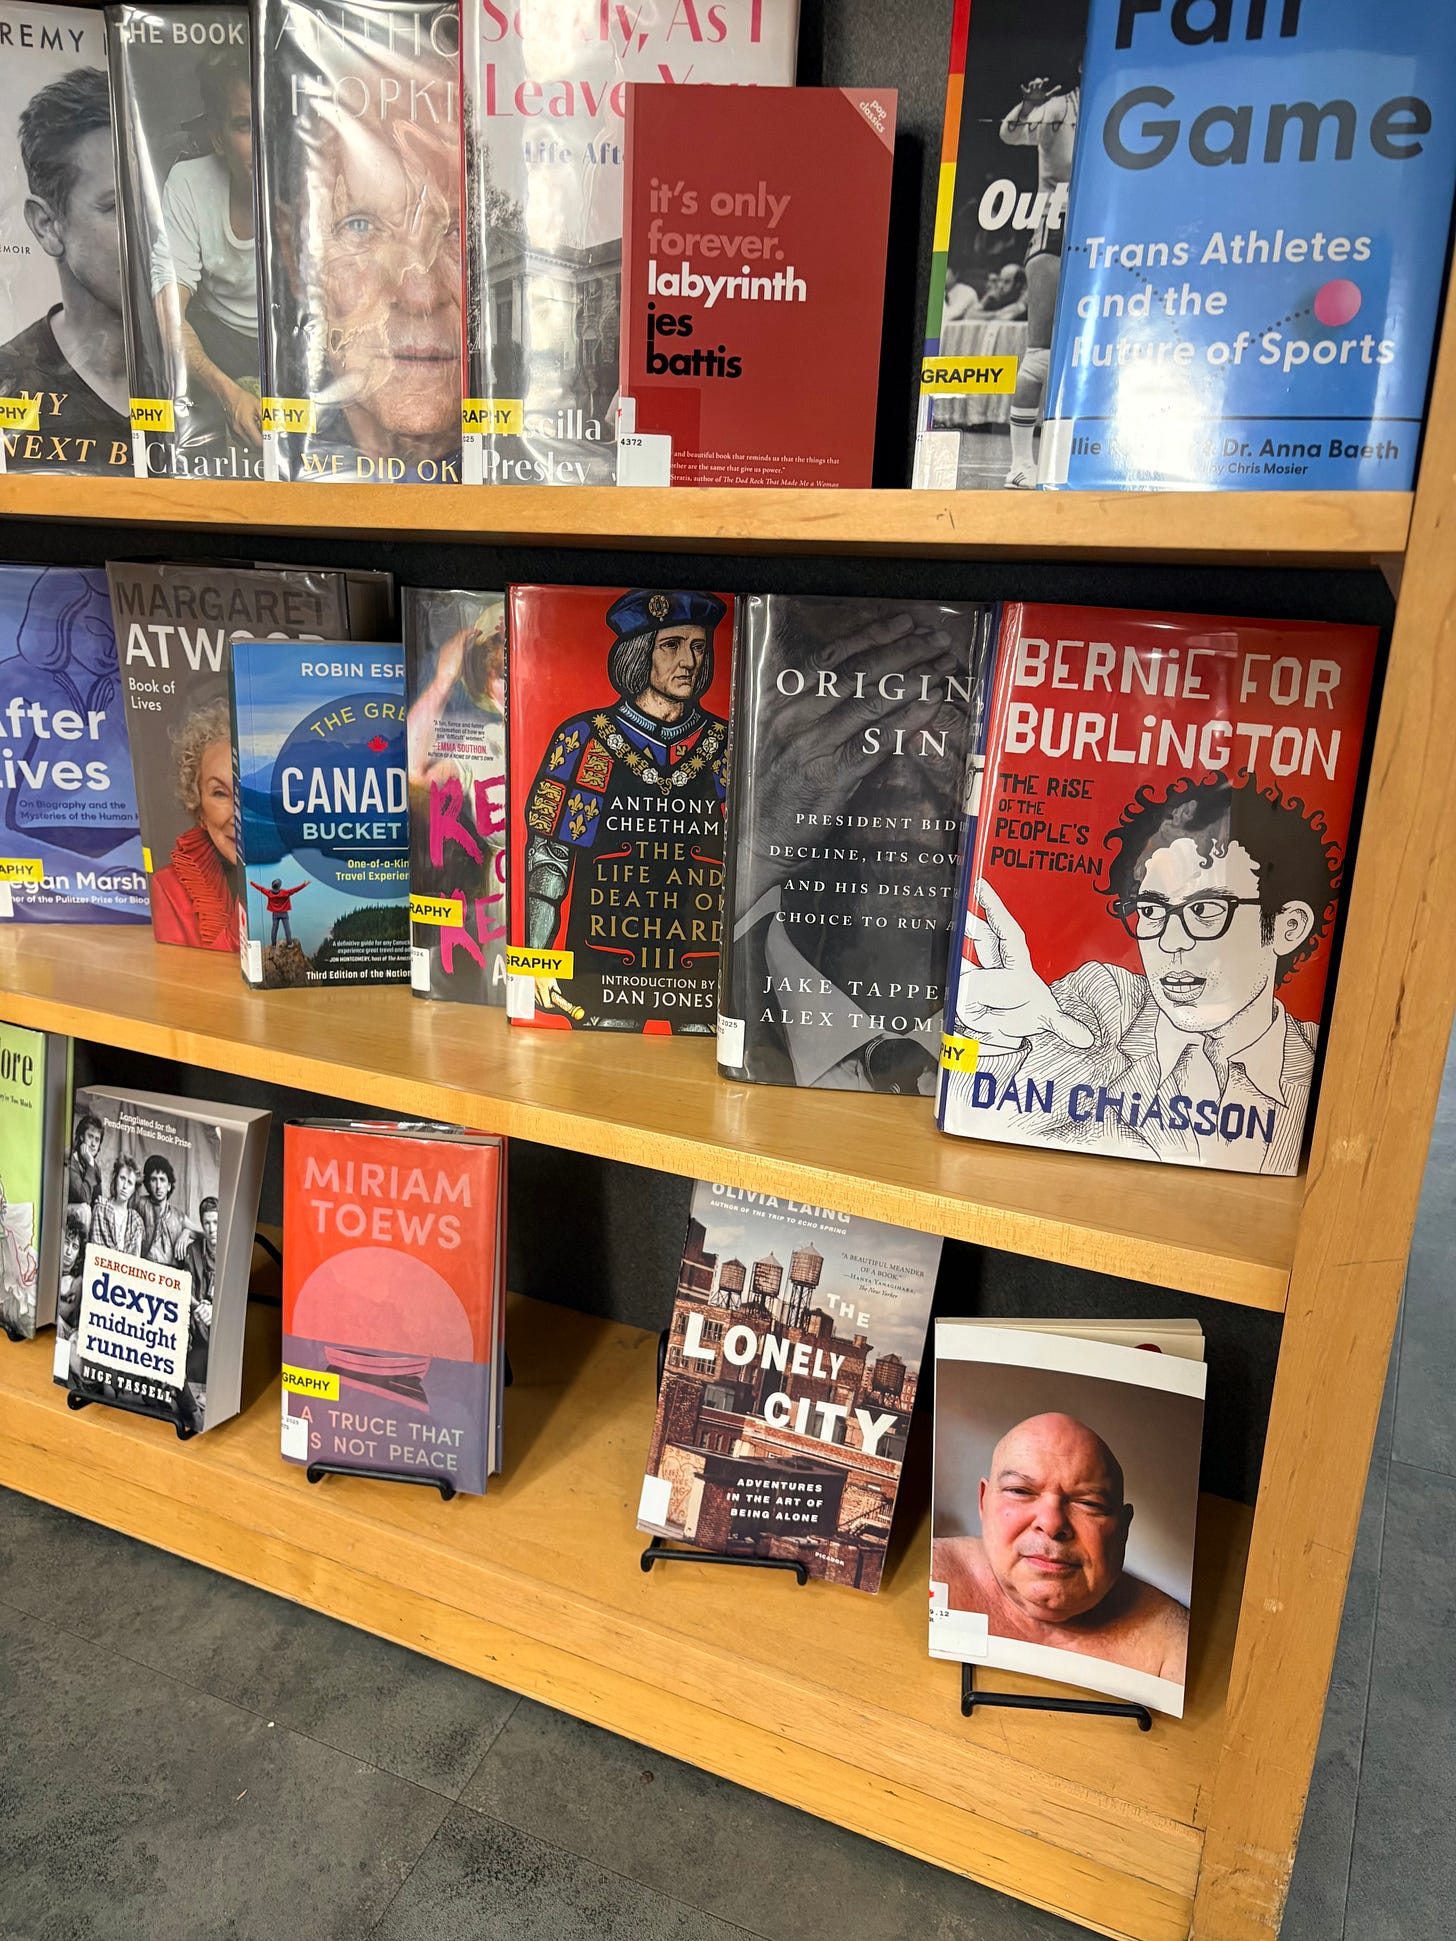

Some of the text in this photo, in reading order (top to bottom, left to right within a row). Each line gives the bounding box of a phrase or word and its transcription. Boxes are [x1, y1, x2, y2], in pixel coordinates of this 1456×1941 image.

[115, 22, 245, 45] THE BOOK
[666, 0, 763, 43] As I
[0, 22, 85, 53] REMY
[291, 74, 456, 124] HOPKI
[869, 99, 887, 119] pop
[859, 101, 886, 133] classics
[1103, 85, 1432, 171] Game
[650, 178, 792, 229] it's only
[977, 179, 1070, 231] Out
[648, 219, 785, 261] forever.
[1085, 229, 1372, 269] Trans Athletes
[648, 259, 807, 308] labyrinth
[1076, 282, 1228, 319] and the
[647, 301, 693, 341] jes
[646, 341, 743, 378] battis
[1071, 331, 1396, 373] Future of Sports
[921, 368, 1004, 384] GRAPHY
[620, 438, 643, 447] 4372
[1223, 439, 1399, 460] Dr. Anna Baeth
[146, 442, 265, 479] Charlie
[357, 456, 406, 481] DID
[483, 449, 591, 485] Presley
[673, 450, 686, 458] and
[686, 451, 715, 459] beautiful
[715, 452, 731, 460] book
[746, 453, 772, 462] reminds
[806, 456, 826, 465] things
[826, 457, 840, 465] that
[740, 465, 754, 474] give
[1228, 462, 1309, 476] Chris Mosier
[115, 582, 326, 627] MARGARET
[301, 662, 364, 678] ROBIN
[1239, 652, 1343, 710] FOR
[128, 677, 176, 694] Book of
[776, 668, 978, 703] ORIGIN
[131, 695, 163, 711] Lives
[310, 705, 357, 738] THE
[862, 727, 949, 757] SIN
[999, 772, 1039, 796] THE
[19, 800, 126, 811] On Biography and the
[20, 811, 134, 821] Mysteries of the Human
[610, 796, 717, 814] ANTHONY
[998, 798, 1046, 816] OF THE
[302, 822, 402, 840] BUCKET
[605, 816, 720, 836] CHEETHAM
[795, 813, 913, 830] PRESIDENT
[994, 817, 1091, 846] PEOPLE'S
[635, 841, 686, 861] THE
[769, 845, 909, 864] DECLINE, ITS
[75, 872, 147, 891] Marsh
[335, 871, 367, 882] Travel
[596, 864, 723, 887] LIFE AND
[783, 878, 869, 894] AND HIS
[589, 887, 679, 910] DEATH
[775, 911, 937, 931] CHOICE TO RUN
[641, 946, 675, 970] III
[306, 969, 385, 980] Third Edition of the
[601, 974, 716, 991] INTRODUCTION BY
[763, 975, 834, 995] JAKE
[602, 989, 714, 1009] DAN JONES
[759, 1007, 835, 1028] ALEX
[971, 1071, 1055, 1114] DAN
[103, 1117, 193, 1149] Penderyn Music Book Prize
[119, 1111, 177, 1135] Longlisted for the
[303, 1156, 473, 1208] MIRIAM
[310, 1199, 462, 1250] TOEWS
[710, 1200, 848, 1236] AUTHOR OF THE TRIP TO ECHO SPRING
[93, 1256, 182, 1291] SEARCHING FOR
[849, 1254, 889, 1269] BEAUTIFUL
[889, 1263, 925, 1278] MEANDER
[860, 1266, 870, 1274] OF
[91, 1272, 179, 1326] dexys
[826, 1292, 871, 1329] THE
[88, 1311, 177, 1351] midnight
[85, 1334, 175, 1376] runners
[682, 1311, 846, 1382] LONELY
[116, 1376, 173, 1404] TASSELL
[328, 1409, 465, 1448] TRUCE THAT
[763, 1391, 899, 1456] CITY
[333, 1436, 458, 1472] NOT PEACE
[736, 1478, 823, 1493] ADVENTURES
[726, 1492, 824, 1509] IN THE ART OF
[730, 1507, 819, 1523] BEING ALONE
[814, 1551, 845, 1567] PICADOR
